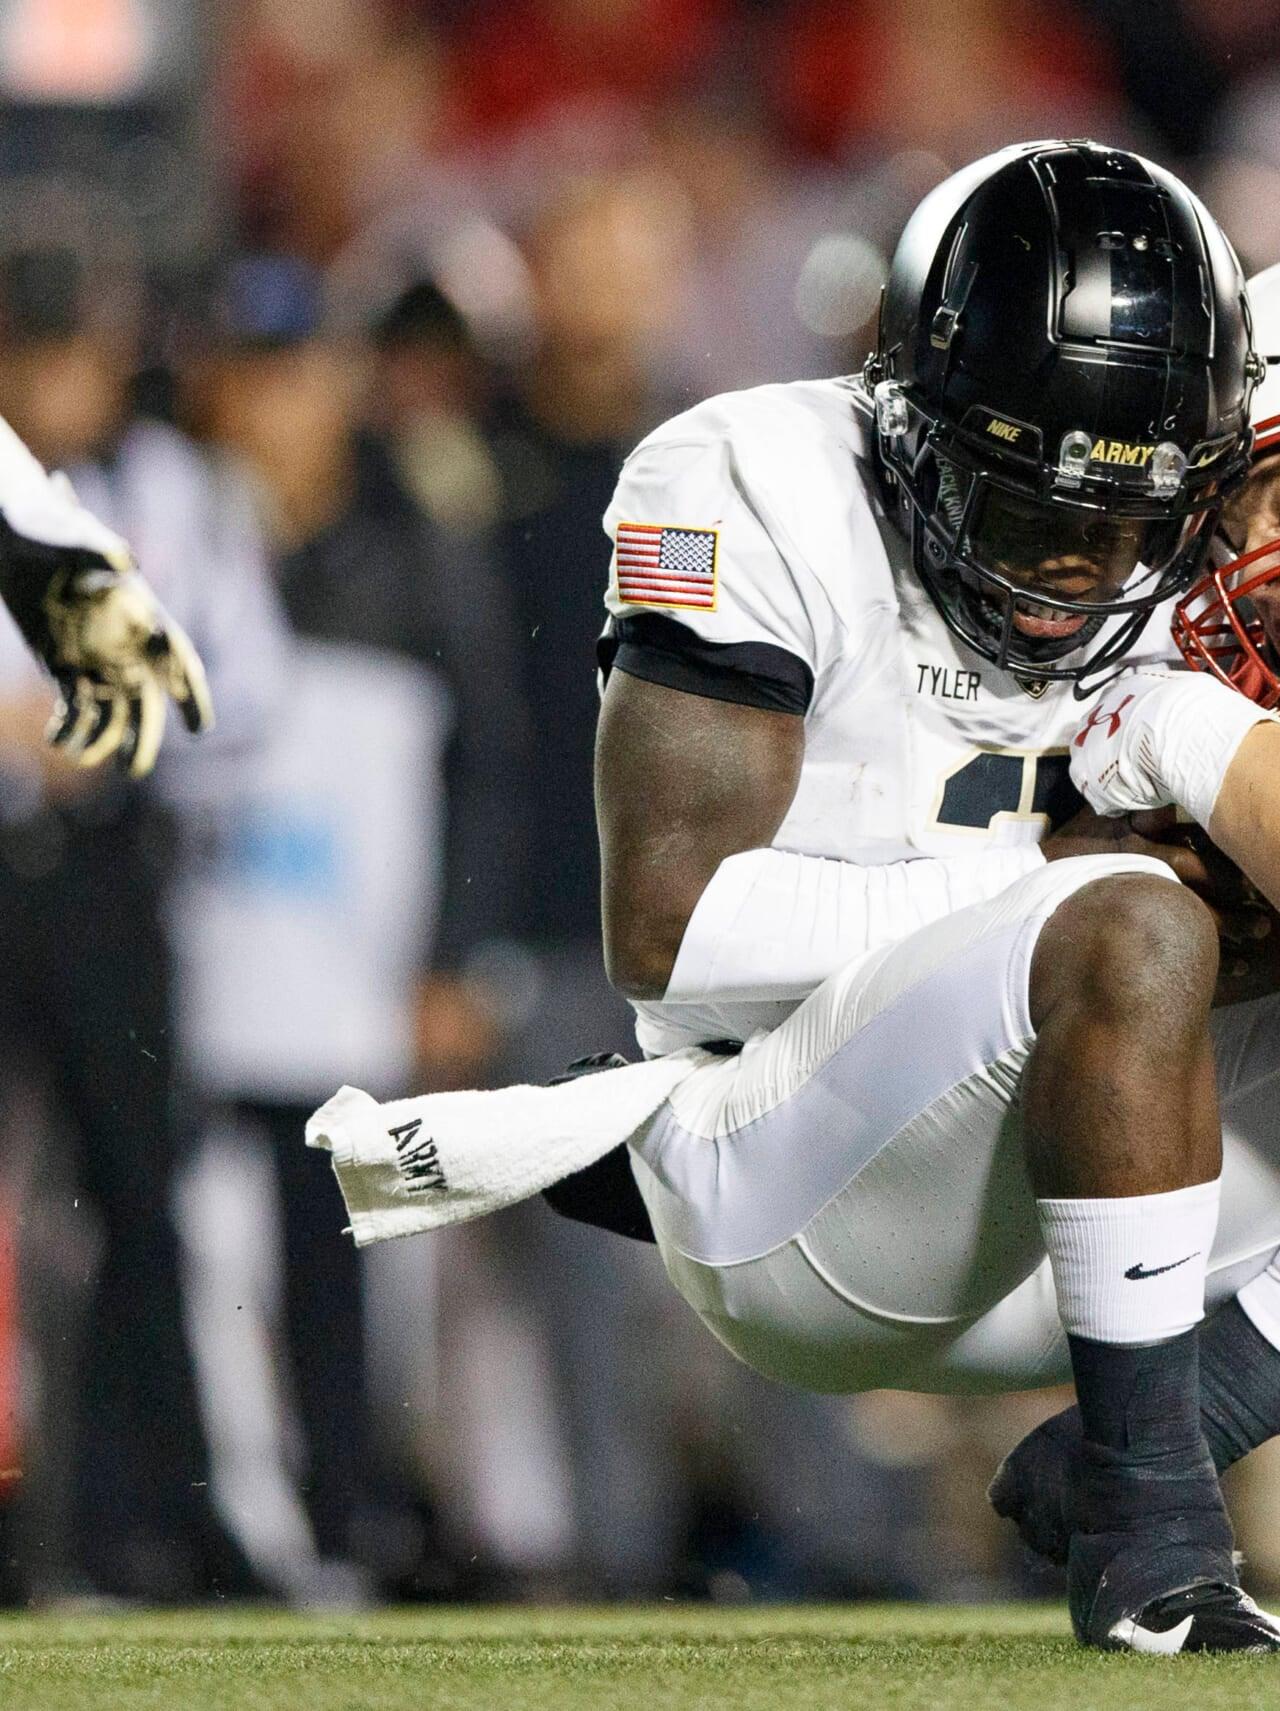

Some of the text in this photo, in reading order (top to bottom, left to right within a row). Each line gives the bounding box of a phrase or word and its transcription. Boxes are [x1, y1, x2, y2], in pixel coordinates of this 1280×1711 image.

[986, 419, 1022, 442] NIKE
[1090, 440, 1155, 467] ARMY
[934, 452, 958, 495] LACK
[917, 663, 982, 701] TYLER
[387, 1117, 449, 1193] ARMY
